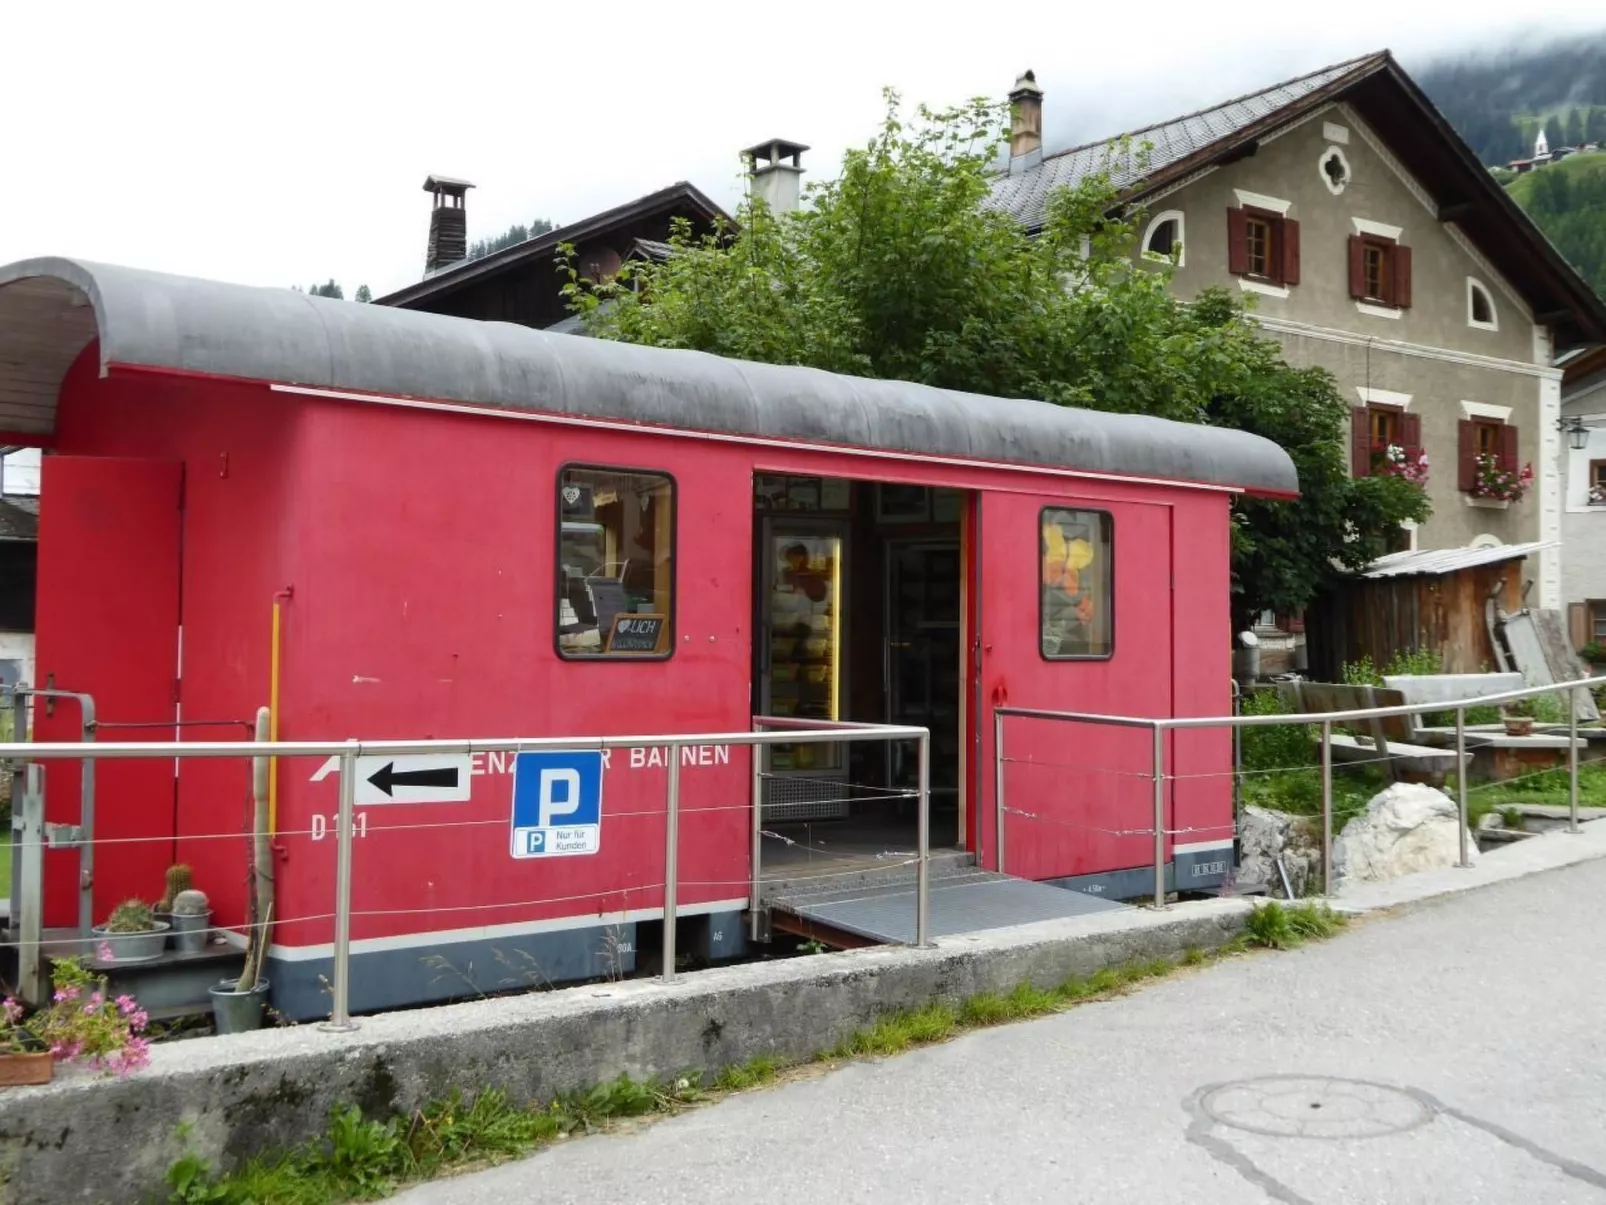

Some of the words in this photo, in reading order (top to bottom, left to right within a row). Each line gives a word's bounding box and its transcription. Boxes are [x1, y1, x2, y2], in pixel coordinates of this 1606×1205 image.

[538, 767, 581, 827] P
[530, 832, 543, 852] P
[556, 831, 571, 840] Nur
[574, 829, 586, 839] für
[556, 841, 587, 852] Kunden
